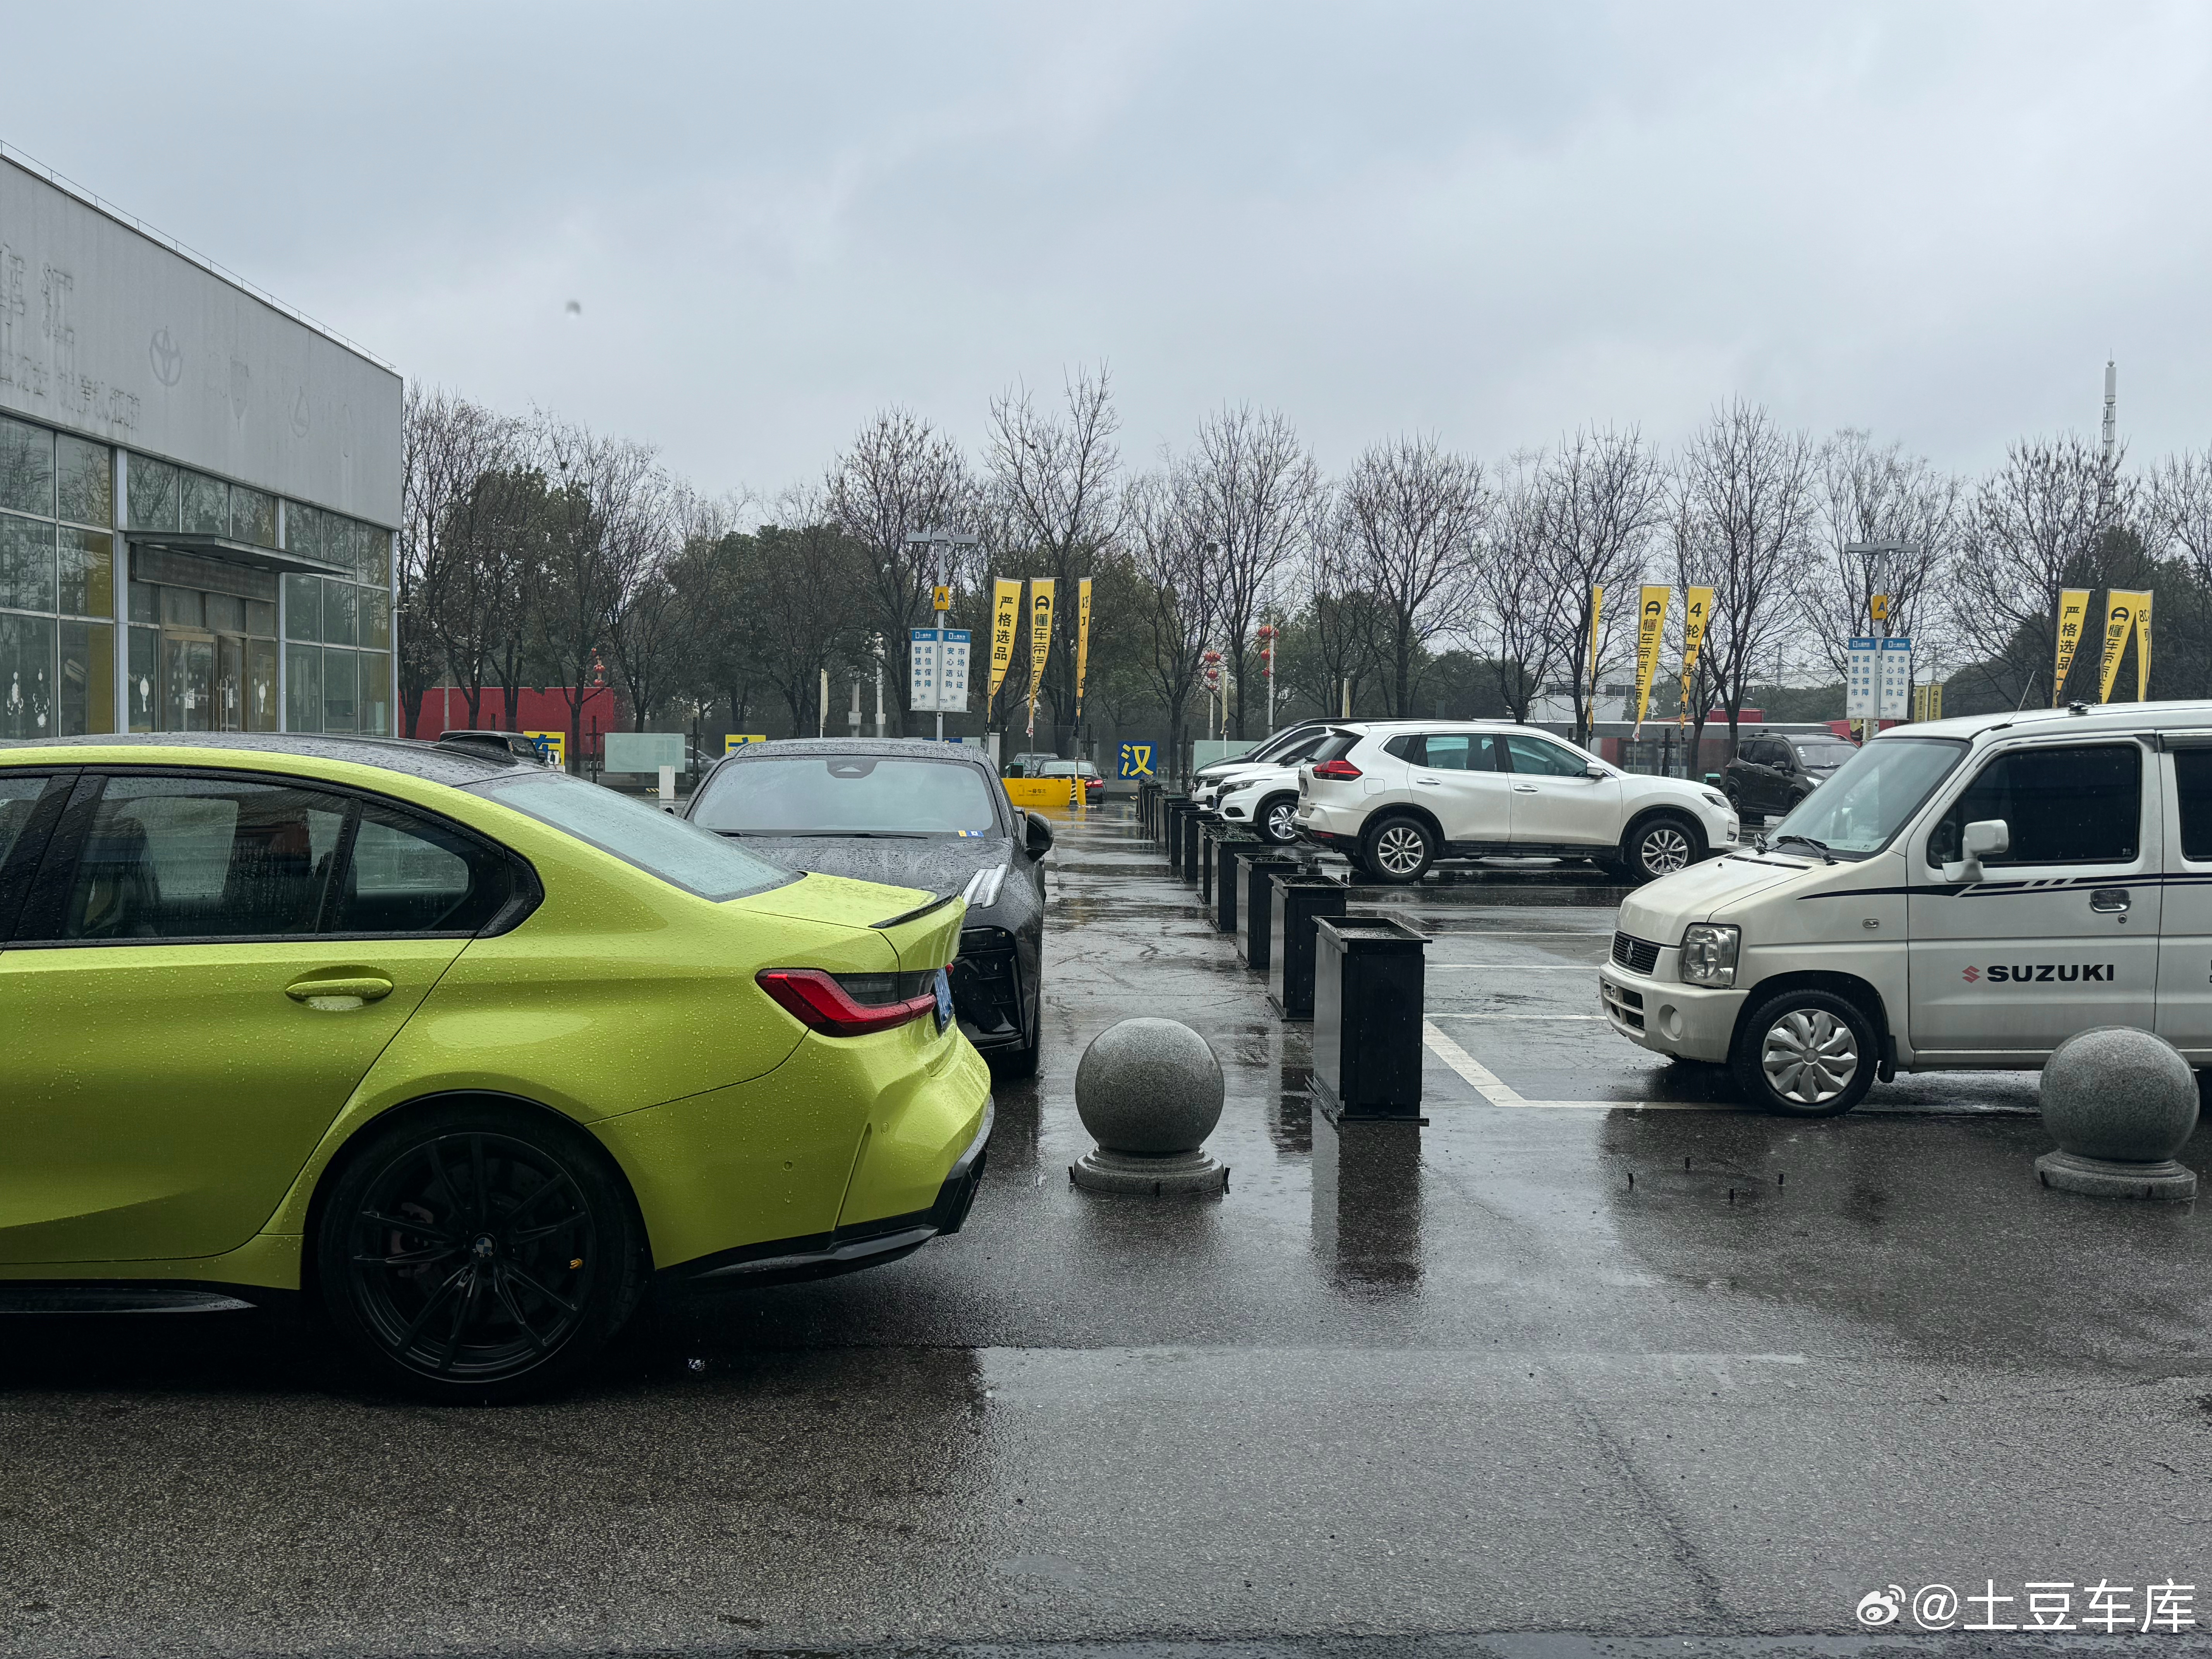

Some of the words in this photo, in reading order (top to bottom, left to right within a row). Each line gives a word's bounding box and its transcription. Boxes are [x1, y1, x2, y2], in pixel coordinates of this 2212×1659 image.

[937, 592, 945, 602] A
[1877, 602, 1885, 611] A
[945, 647, 954, 688] 安心选购
[957, 648, 965, 689] 市场认证
[1886, 656, 1894, 696] 安心选购
[1897, 656, 1905, 696] 市场认证
[1121, 744, 1154, 776] 汉
[1987, 964, 2114, 983] SUZUKI
